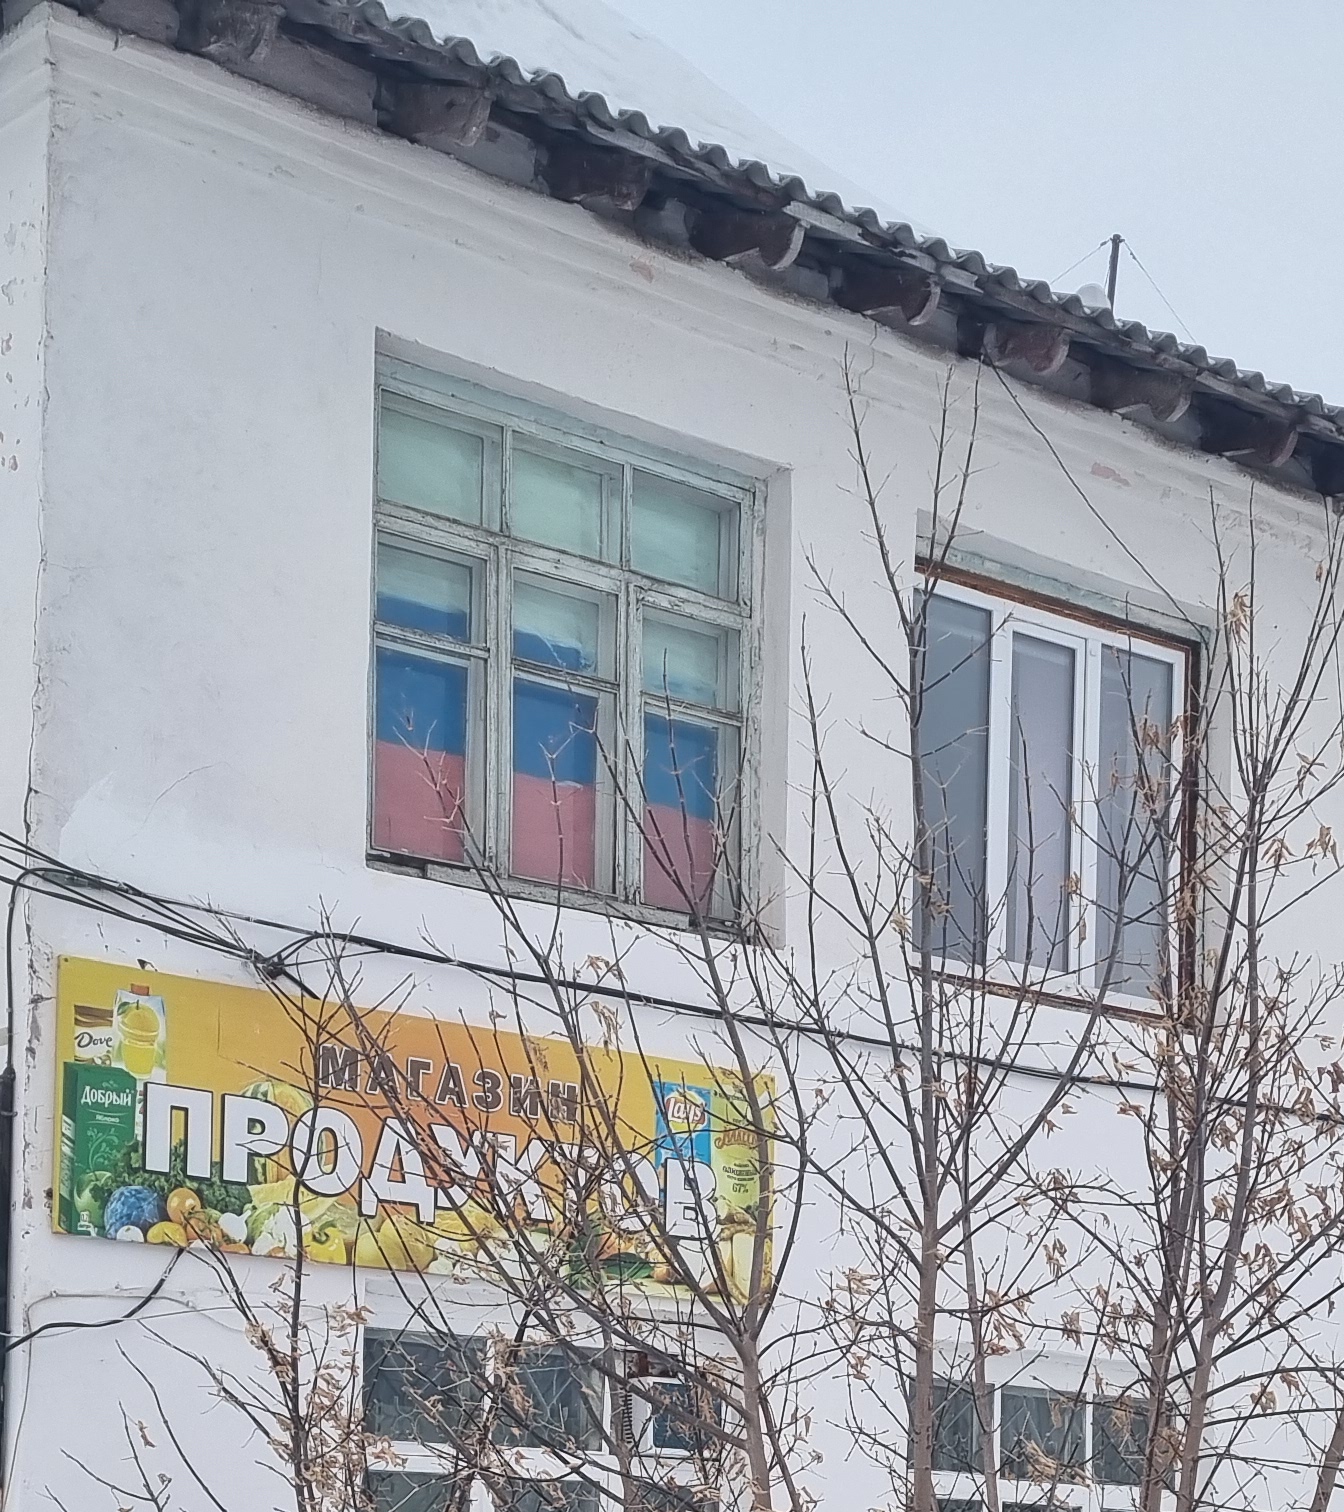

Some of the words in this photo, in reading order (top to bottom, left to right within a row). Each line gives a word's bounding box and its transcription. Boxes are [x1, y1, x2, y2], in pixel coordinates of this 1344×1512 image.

[74, 1031, 113, 1048] Dove
[319, 1043, 579, 1126] МАГАЗИН
[143, 1081, 719, 1241] ПРОДУКТОВ
